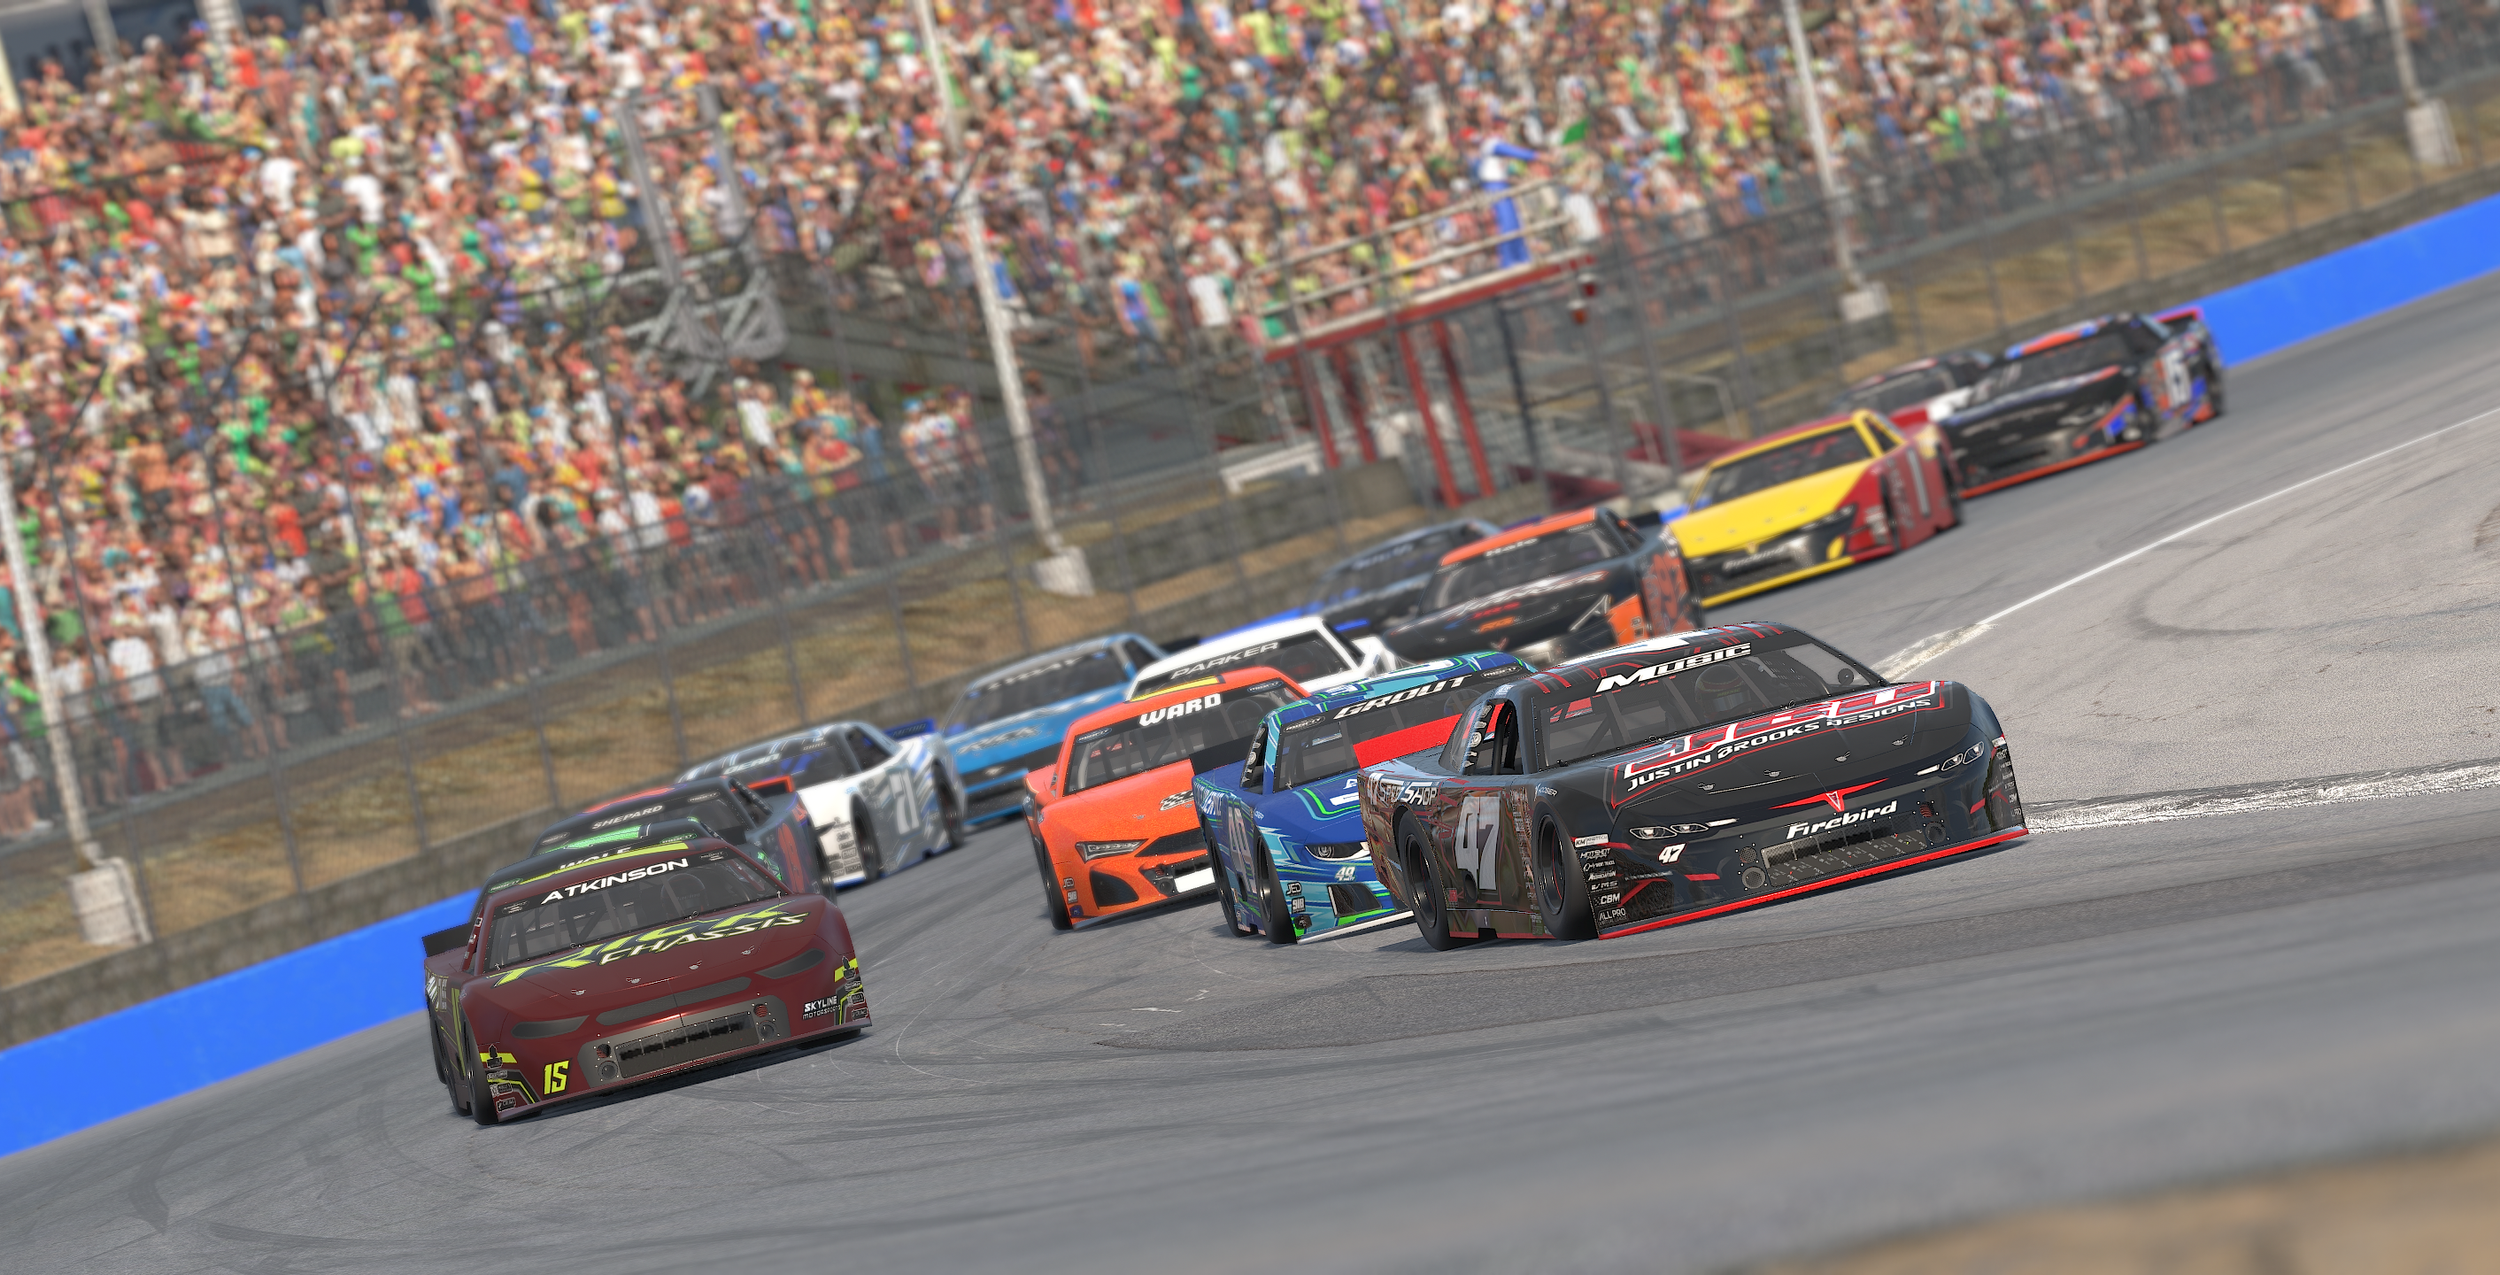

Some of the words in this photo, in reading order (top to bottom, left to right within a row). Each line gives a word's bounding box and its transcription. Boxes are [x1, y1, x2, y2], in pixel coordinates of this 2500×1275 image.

[1170, 641, 1279, 680] PARKER
[1138, 693, 1223, 728] WARD
[1333, 675, 1472, 720] GROUT
[1627, 753, 1712, 793] JUSTIN
[1717, 721, 1820, 760] BROOKS
[1826, 698, 1932, 727] DESIGNS
[1400, 781, 1439, 806] SHOP
[591, 804, 665, 831] SHEPARD
[1787, 801, 1899, 840] Firebird
[1455, 796, 1501, 890] 47
[1658, 843, 1686, 864] 47
[541, 858, 690, 905] ATKINSON
[1600, 893, 1621, 905] CBM
[599, 912, 811, 966] CHASSIS
[804, 995, 838, 1013] SKYLINE
[543, 1059, 570, 1096] 15
